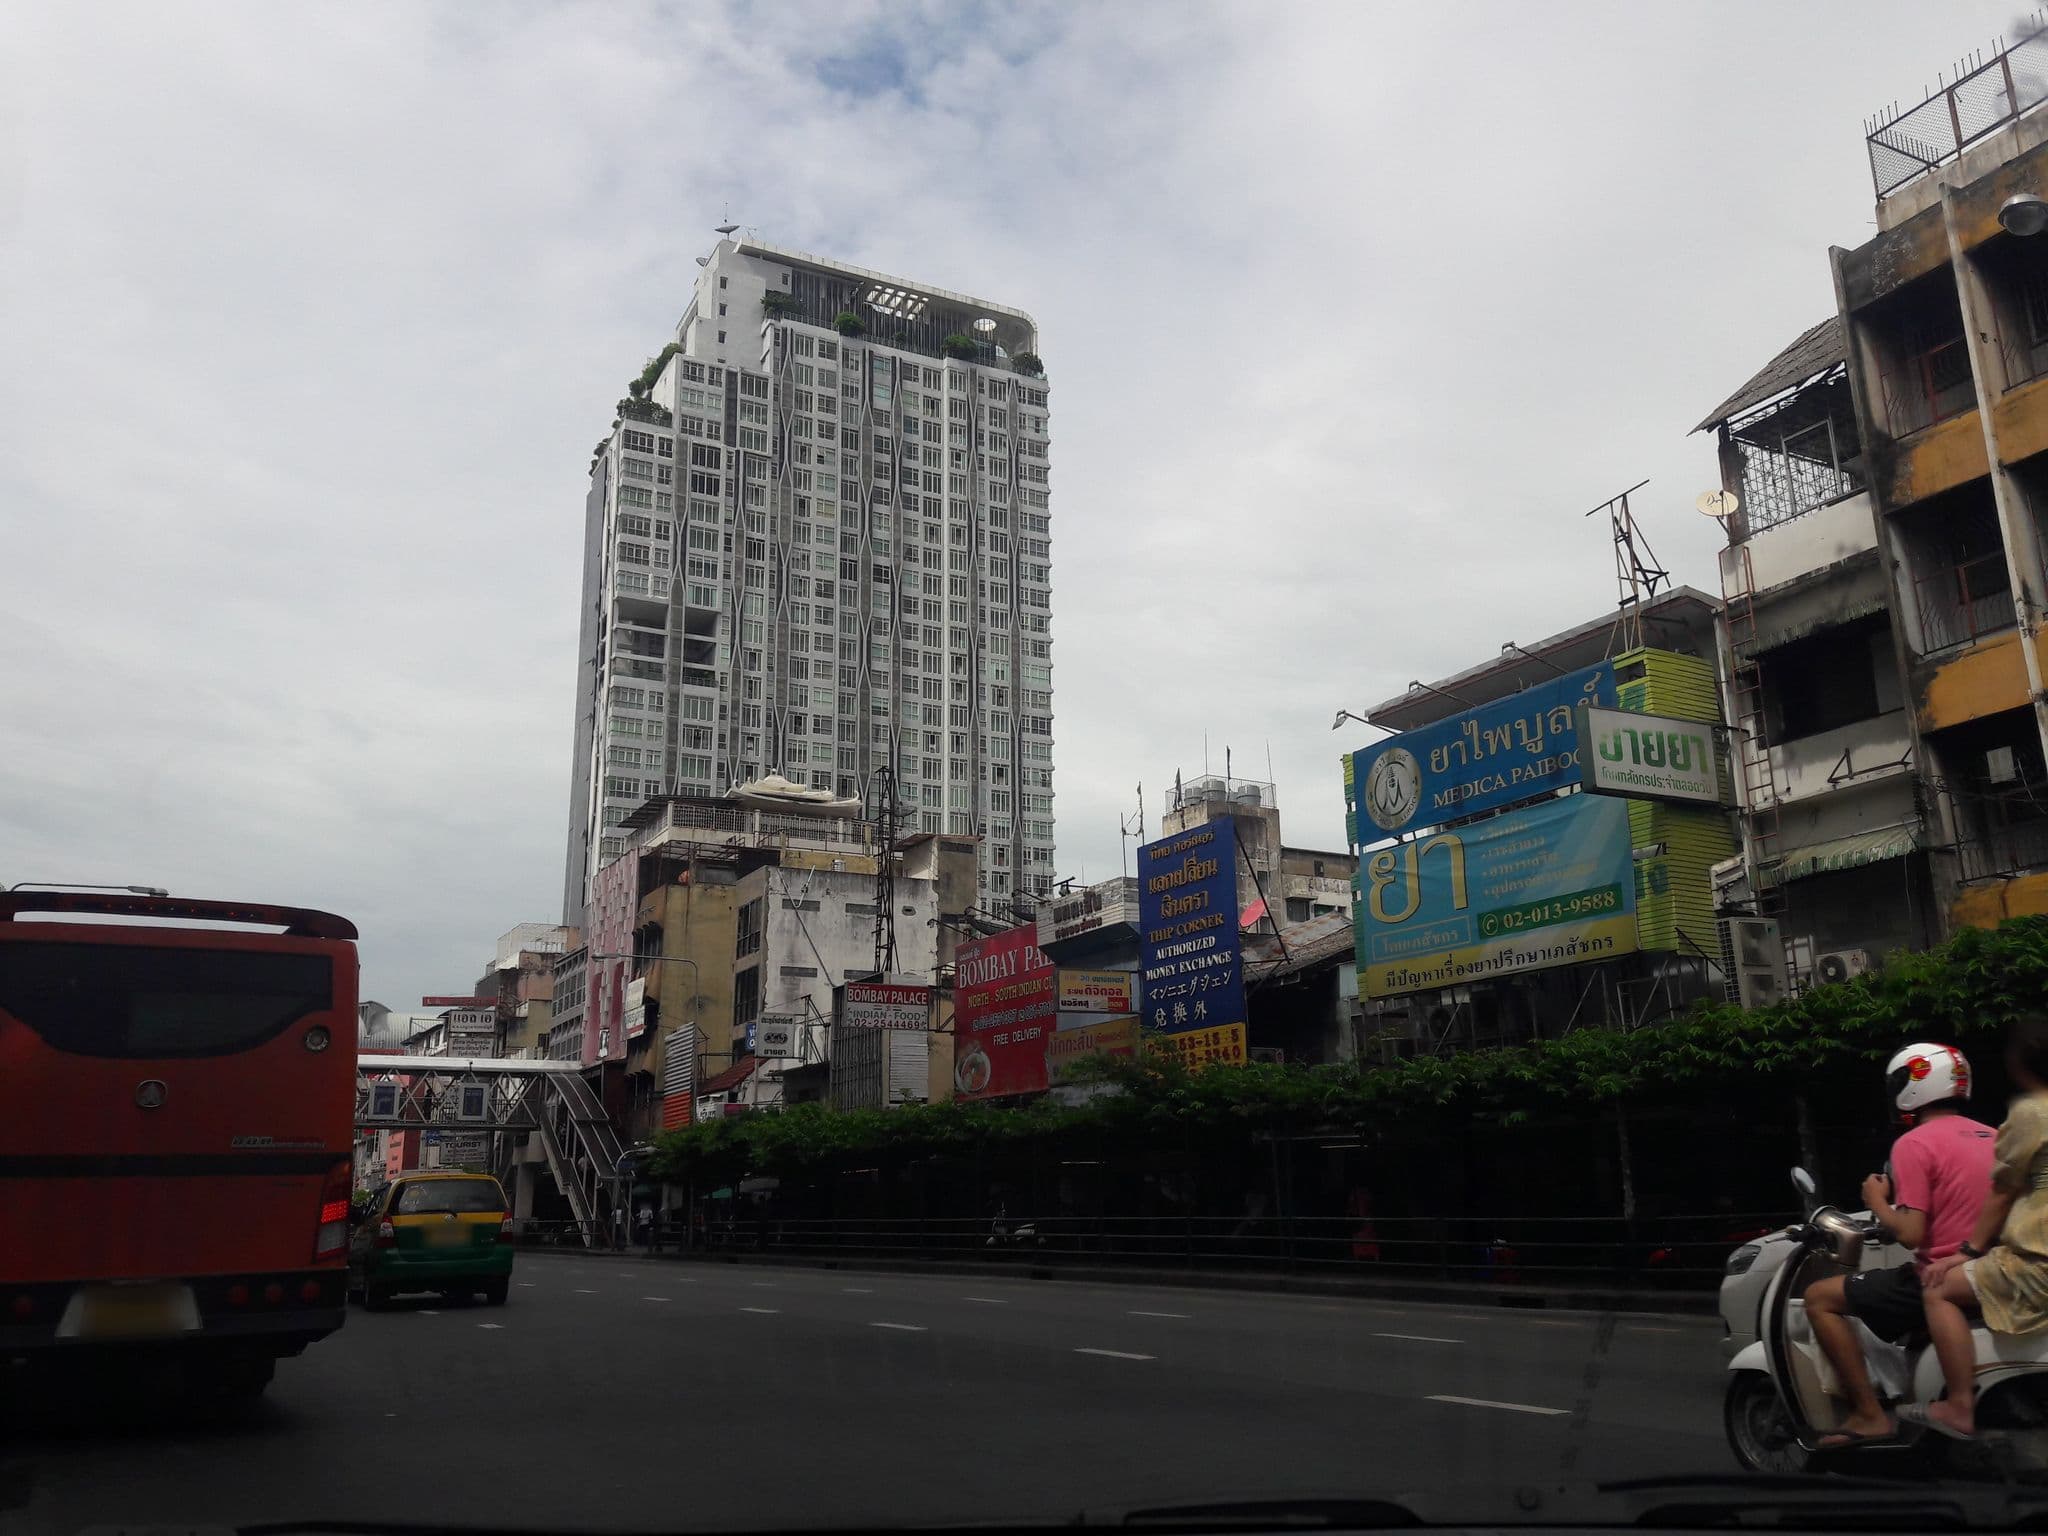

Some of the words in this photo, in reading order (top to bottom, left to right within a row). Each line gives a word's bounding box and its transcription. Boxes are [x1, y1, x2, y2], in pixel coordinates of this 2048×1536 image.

[1433, 774, 1510, 809] MEDICA
[1148, 850, 1218, 895] แลกเปลี่ยน
[1368, 833, 1469, 924] ยา
[1160, 890, 1209, 919] เงินตรา
[1502, 889, 1616, 929] 02-013-9588
[1176, 912, 1225, 936] CORNER
[1155, 936, 1216, 961] AUTHORIZED
[959, 949, 1018, 989] BOMBAY
[1146, 965, 1177, 981] MONEY
[1179, 950, 1233, 974] EXCHANGE
[847, 988, 890, 1002] BOMBAY
[891, 991, 928, 1005] PALACE
[853, 1011, 887, 1019] INDIAN
[894, 1011, 921, 1021] FOOD
[993, 1032, 1009, 1046] FREE
[1012, 1026, 1042, 1043] DELIVERY
[444, 1141, 481, 1149] TOURIST
